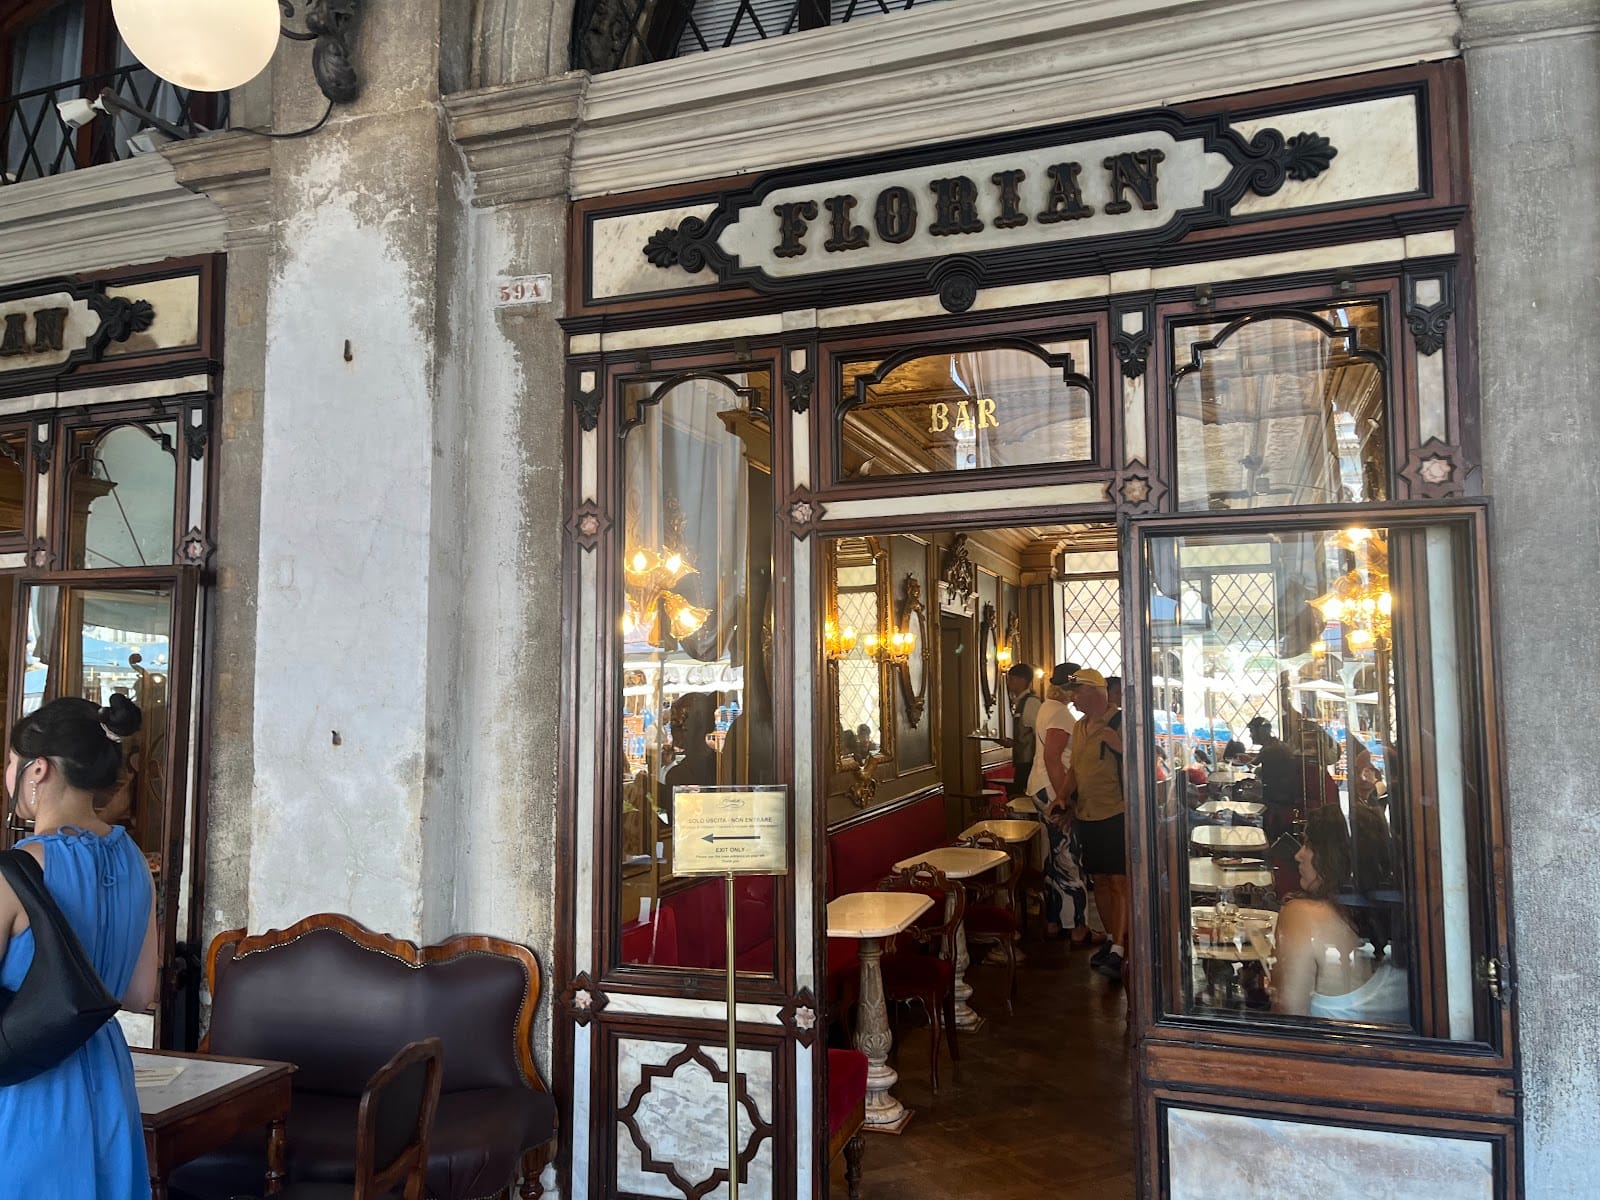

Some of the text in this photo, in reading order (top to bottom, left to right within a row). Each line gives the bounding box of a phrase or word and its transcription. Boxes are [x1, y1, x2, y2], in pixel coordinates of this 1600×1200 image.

[772, 148, 1166, 258] FLORIAN
[0, 307, 69, 357] AN
[928, 398, 999, 433] BAR
